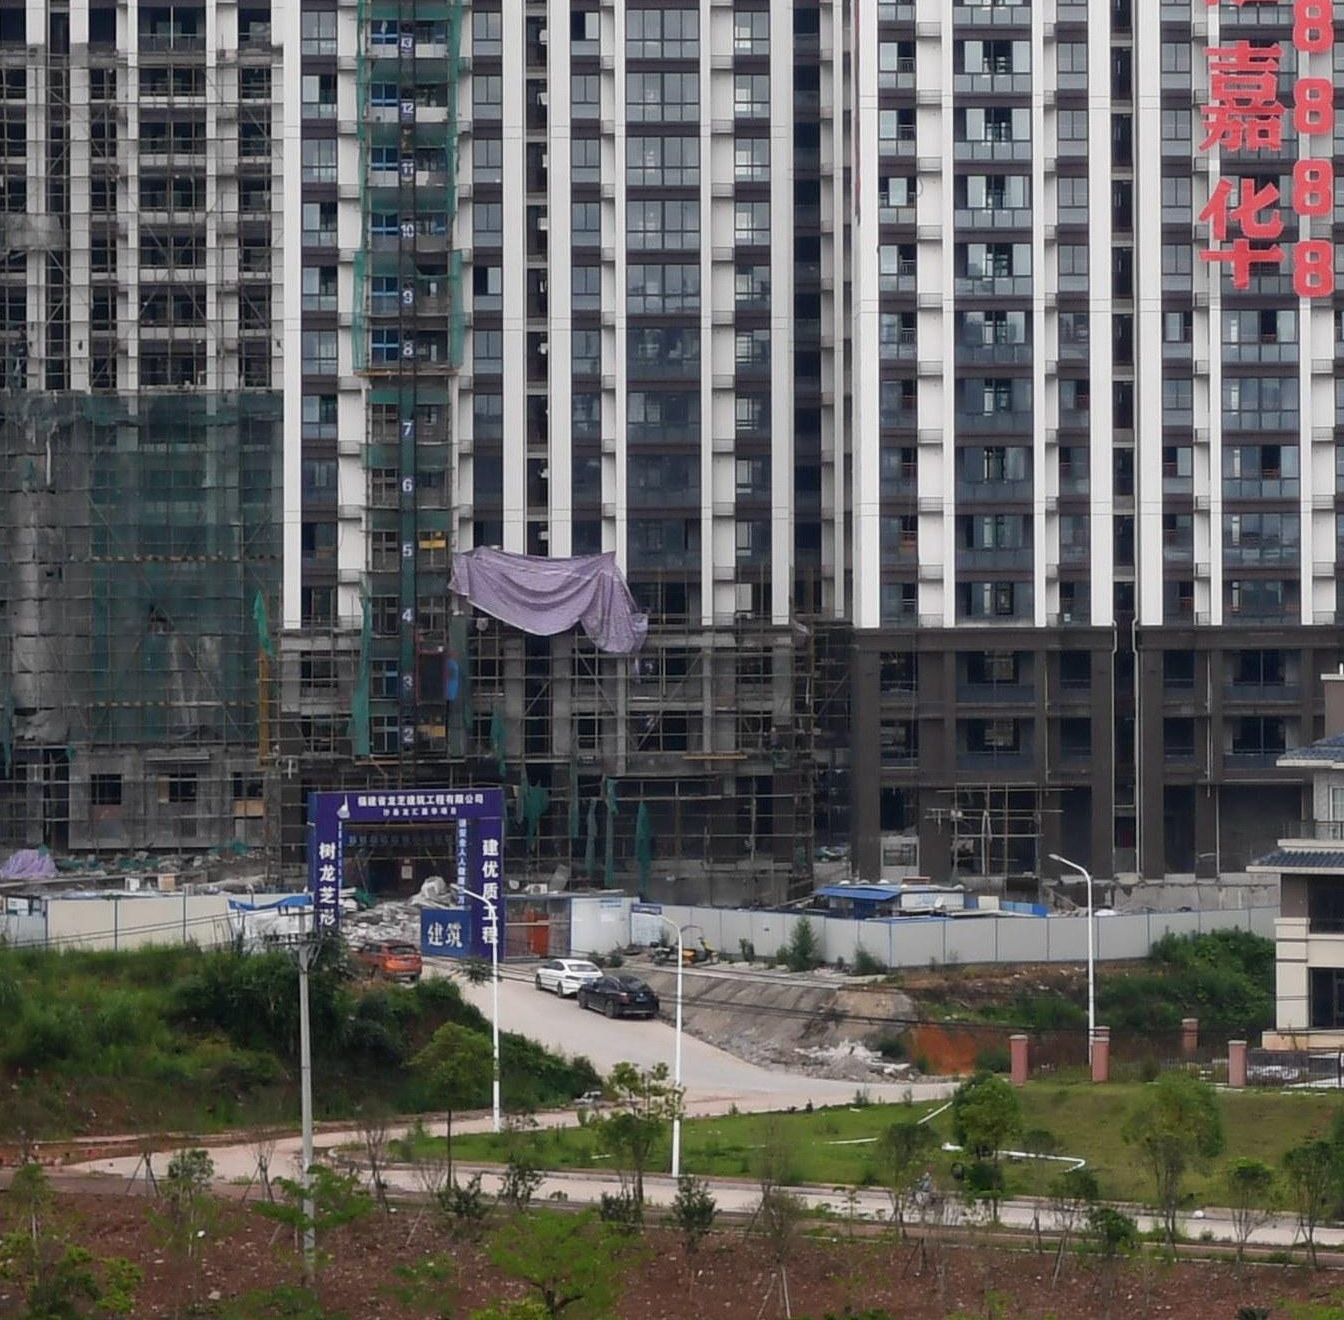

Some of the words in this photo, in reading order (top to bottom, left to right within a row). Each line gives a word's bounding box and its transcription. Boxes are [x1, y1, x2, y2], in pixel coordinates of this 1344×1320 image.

[402, 422, 412, 436] 7
[402, 478, 412, 492] 6
[402, 544, 412, 557] 5
[402, 608, 413, 622] 4
[404, 728, 414, 742] 2
[481, 839, 499, 945] 建优质工程
[427, 921, 463, 948] 建筑
